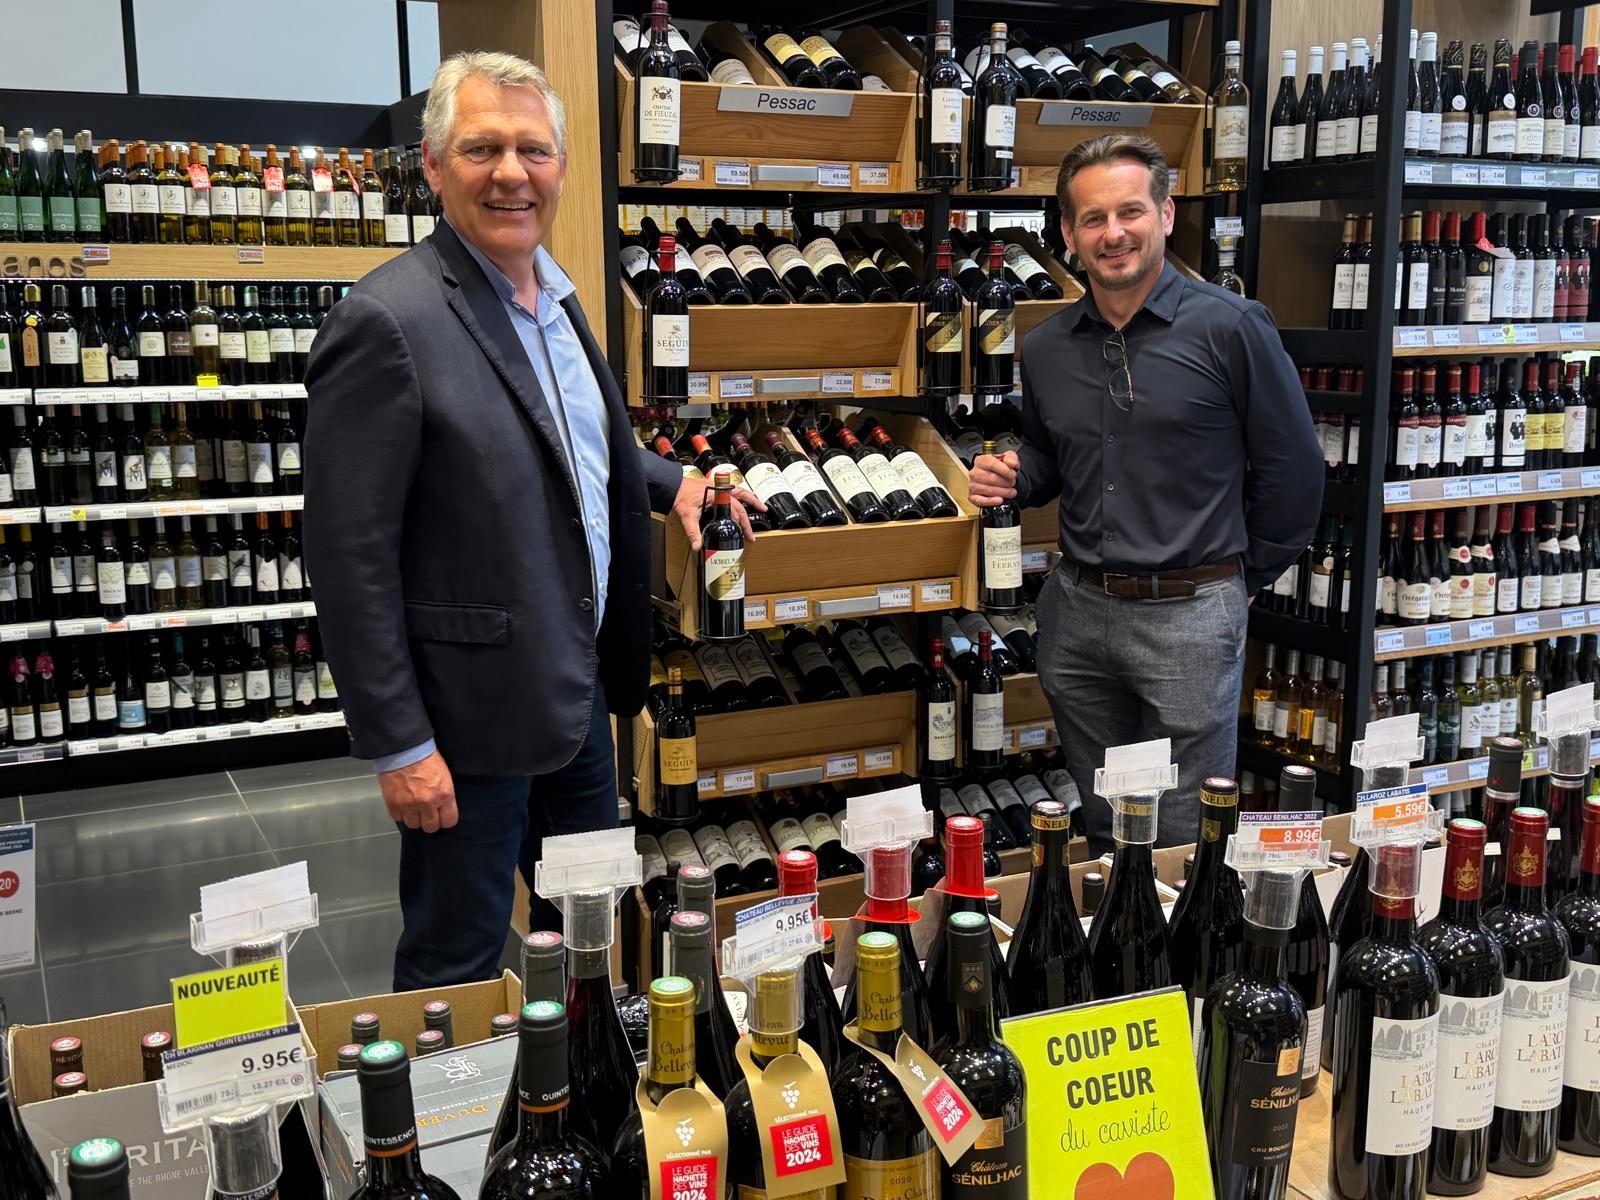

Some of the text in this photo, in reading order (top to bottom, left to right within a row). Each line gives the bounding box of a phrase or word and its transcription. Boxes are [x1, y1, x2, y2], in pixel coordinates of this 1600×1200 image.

[757, 92, 816, 112] Pessac
[1071, 106, 1121, 122] Pessac
[1395, 801, 1425, 817] 5.59€
[1284, 829, 1320, 843] 8.99€
[737, 907, 765, 922] CHATEAU
[776, 909, 811, 932] 9.95€
[177, 965, 280, 1000] NOUVEAUTÉ
[215, 1031, 271, 1047] QUINTESSENCE
[1047, 1018, 1160, 1067] COUP DE
[166, 1060, 193, 1070] MEDOC
[242, 1047, 303, 1074] 9.95€
[1066, 1066, 1155, 1110] COEUR
[943, 1106, 964, 1131] 2024
[1060, 1100, 1172, 1153] du caviste
[782, 1124, 817, 1138] LE GUIDE
[783, 1131, 819, 1146] HACHETTE
[784, 1139, 820, 1153] DES VINS
[786, 1147, 822, 1167] 2024
[138, 1172, 153, 1185] THE
[154, 1169, 182, 1182] RHONE
[672, 1164, 707, 1175] LE GUIDE
[952, 1165, 1023, 1187] SÉNILHAC
[673, 1173, 708, 1183] HACHETTE
[673, 1179, 708, 1191] DES VINS
[673, 1189, 707, 1200] 2024
